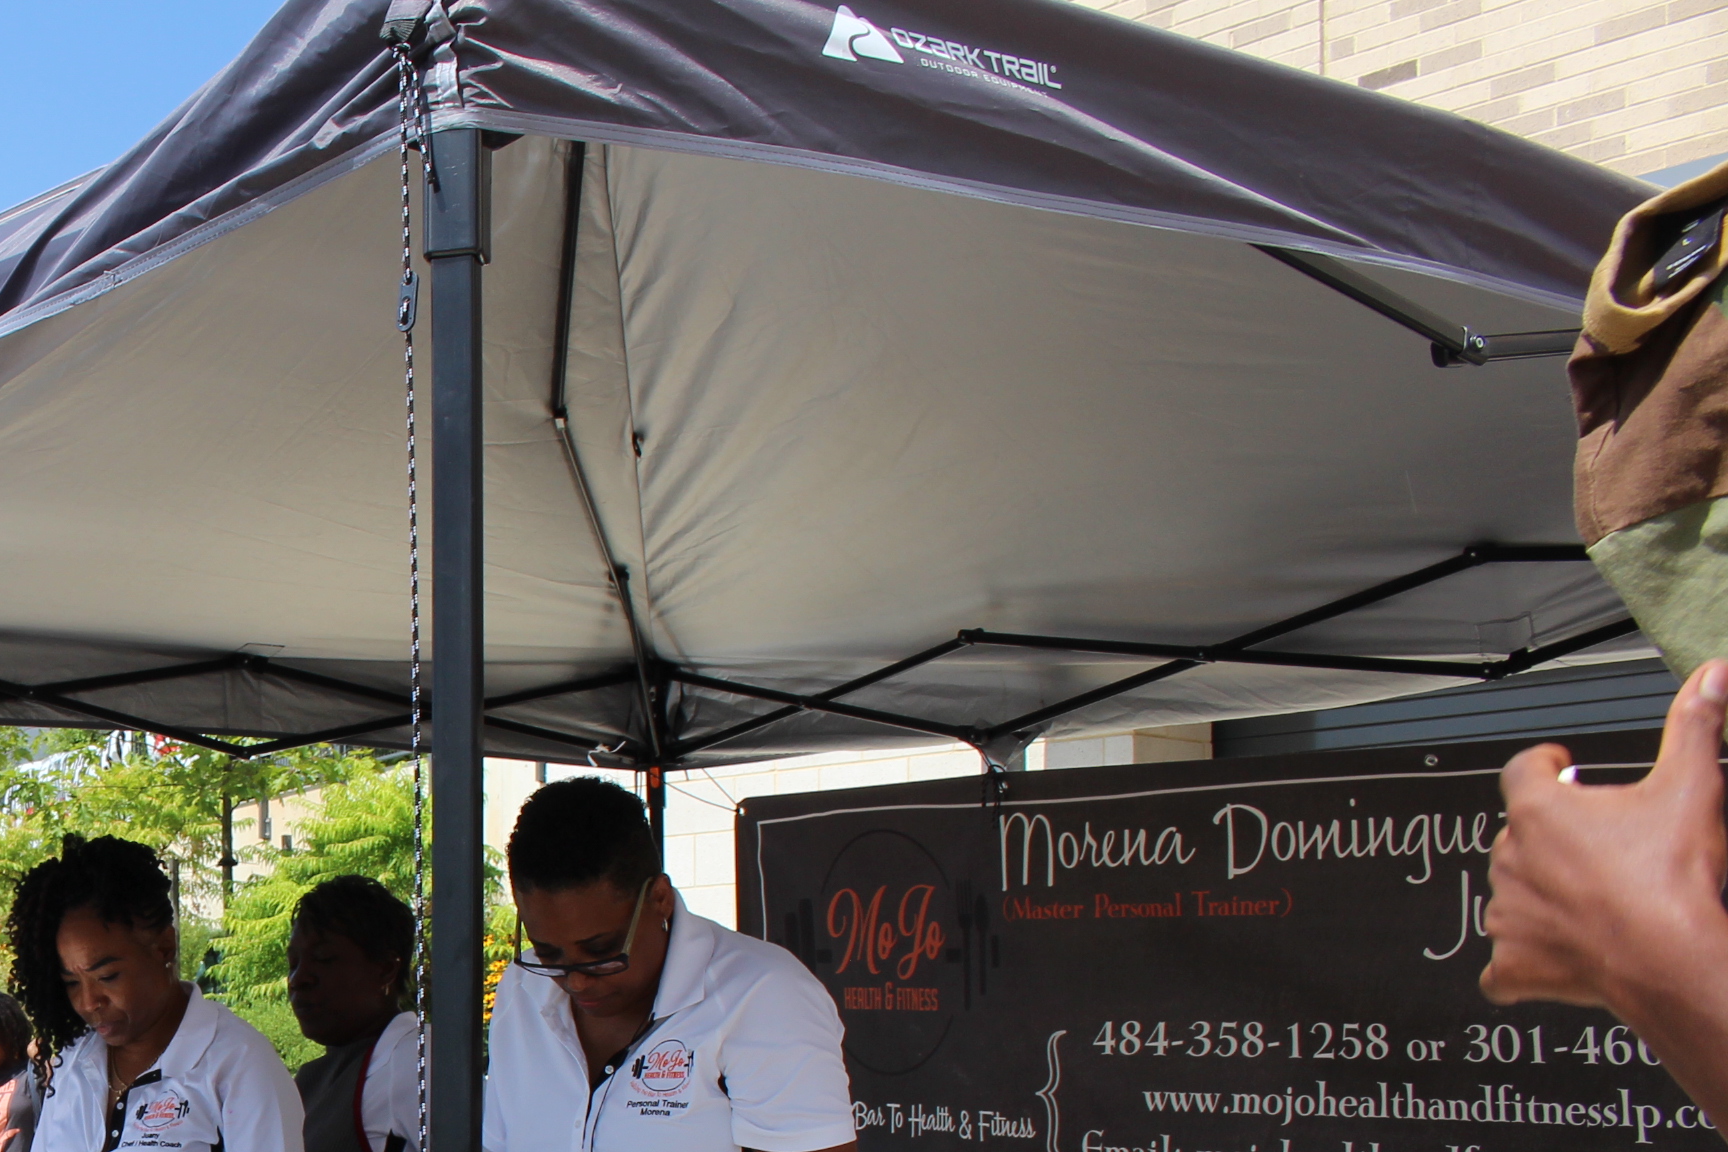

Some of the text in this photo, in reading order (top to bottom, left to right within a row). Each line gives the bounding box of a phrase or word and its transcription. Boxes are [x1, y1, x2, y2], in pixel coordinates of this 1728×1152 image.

[920, 57, 979, 79] OUTDOOR
[999, 798, 1508, 891] Morena Domingue
[1003, 887, 1294, 921] (Master Personal Trainer)
[827, 884, 947, 980] MoJo
[844, 981, 939, 1011] HEALTH & FITNESS
[1093, 1020, 1389, 1061] 484-358-1258
[1406, 1038, 1446, 1062] or
[626, 1100, 690, 1109] Personal Trainer
[640, 1107, 671, 1117] Morena
[852, 1101, 1036, 1142] Bar To Health & Fitness
